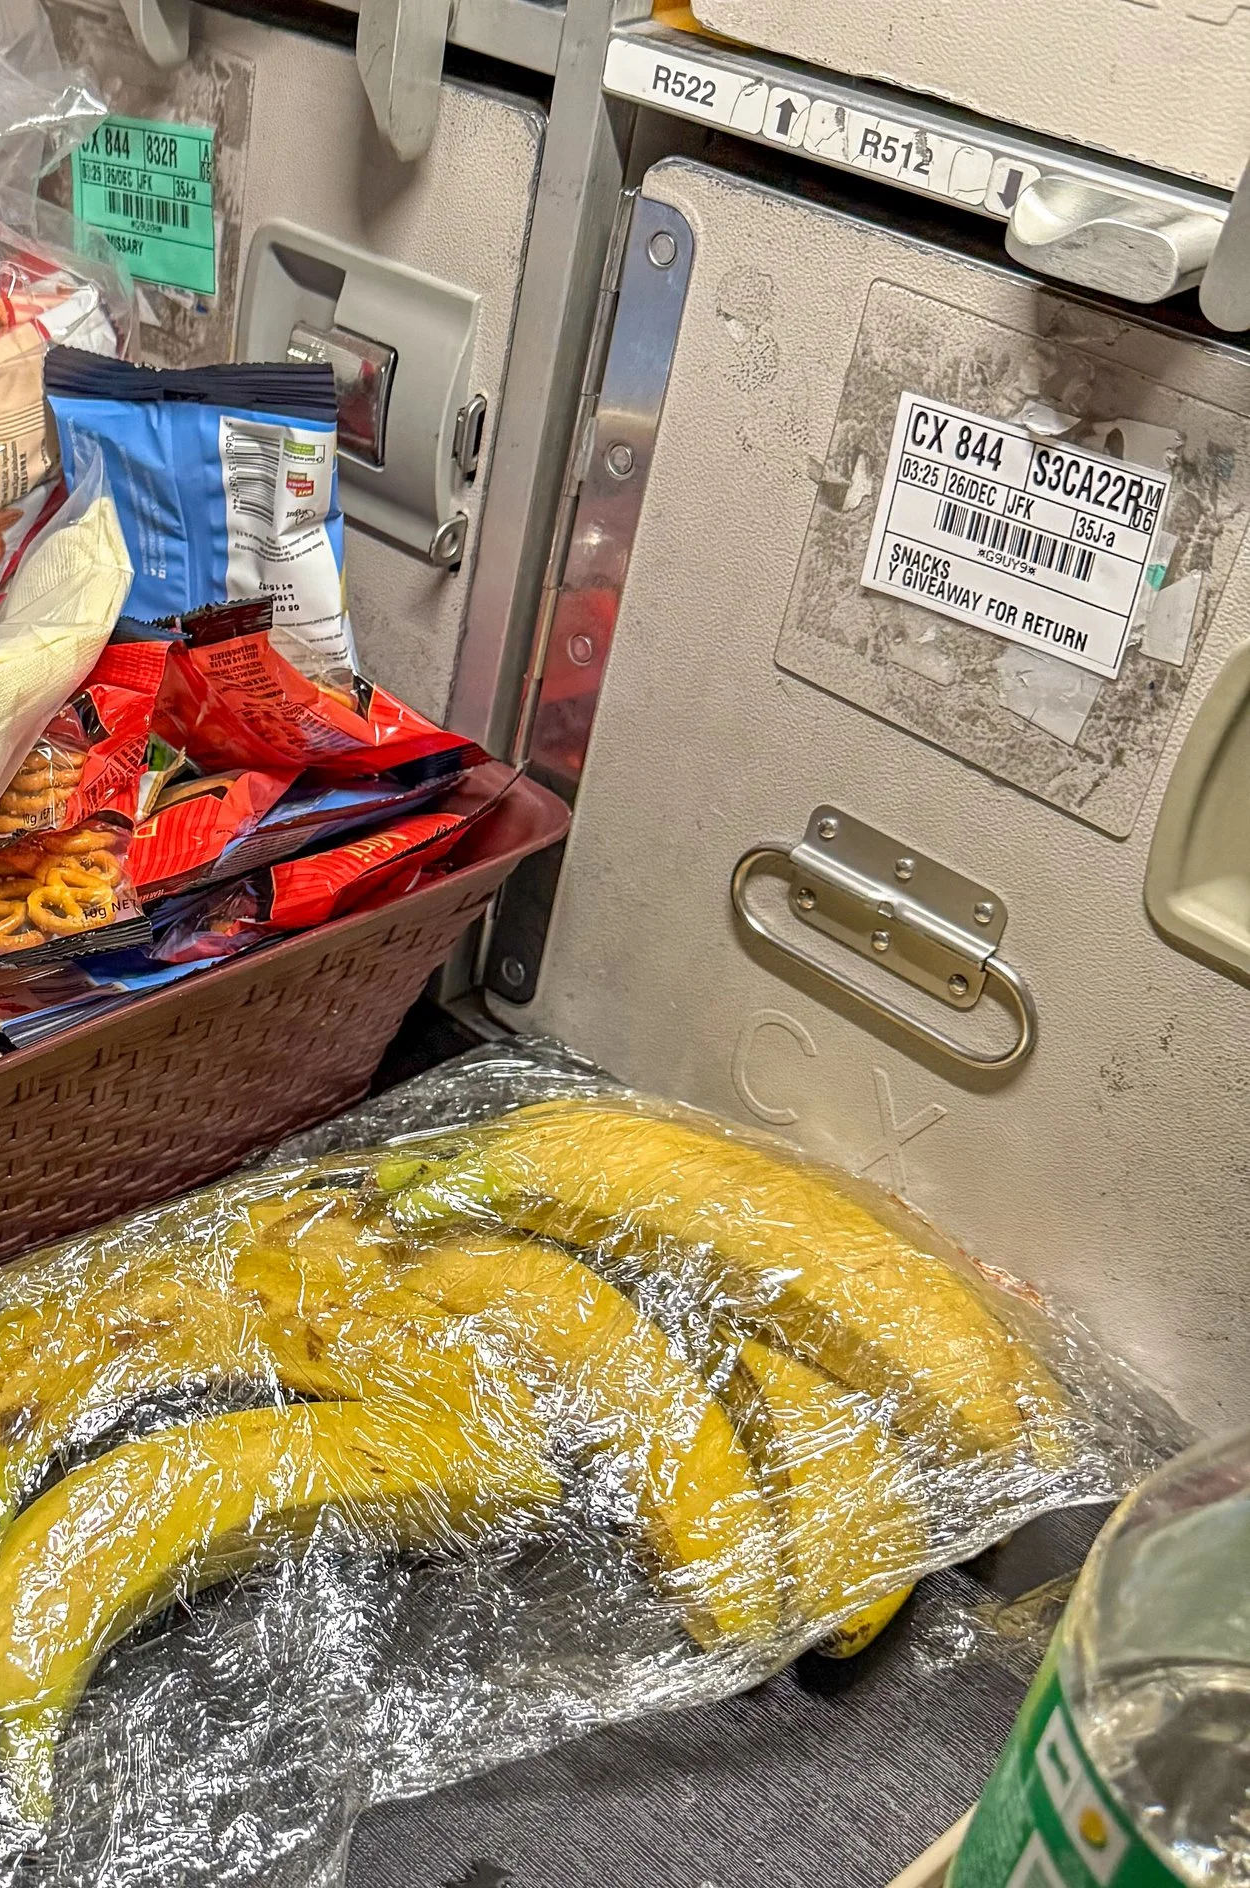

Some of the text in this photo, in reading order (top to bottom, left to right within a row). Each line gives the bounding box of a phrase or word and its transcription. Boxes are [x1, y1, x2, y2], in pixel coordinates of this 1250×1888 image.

[652, 64, 717, 108] R522
[105, 127, 130, 160] 844
[146, 135, 177, 168] 832R
[859, 130, 934, 175] R512
[106, 167, 132, 188] 26/DEC
[138, 174, 152, 192] JFK
[911, 411, 1162, 515] CX 844 S3CA22R M
[902, 458, 940, 488] 03:25
[948, 473, 997, 507] 26/DEC
[1008, 494, 1035, 519] JFK
[1132, 508, 1154, 532] 06
[891, 543, 951, 580] SNACKS
[887, 562, 1089, 652] Y GIVEAWAY FOR RETURN
